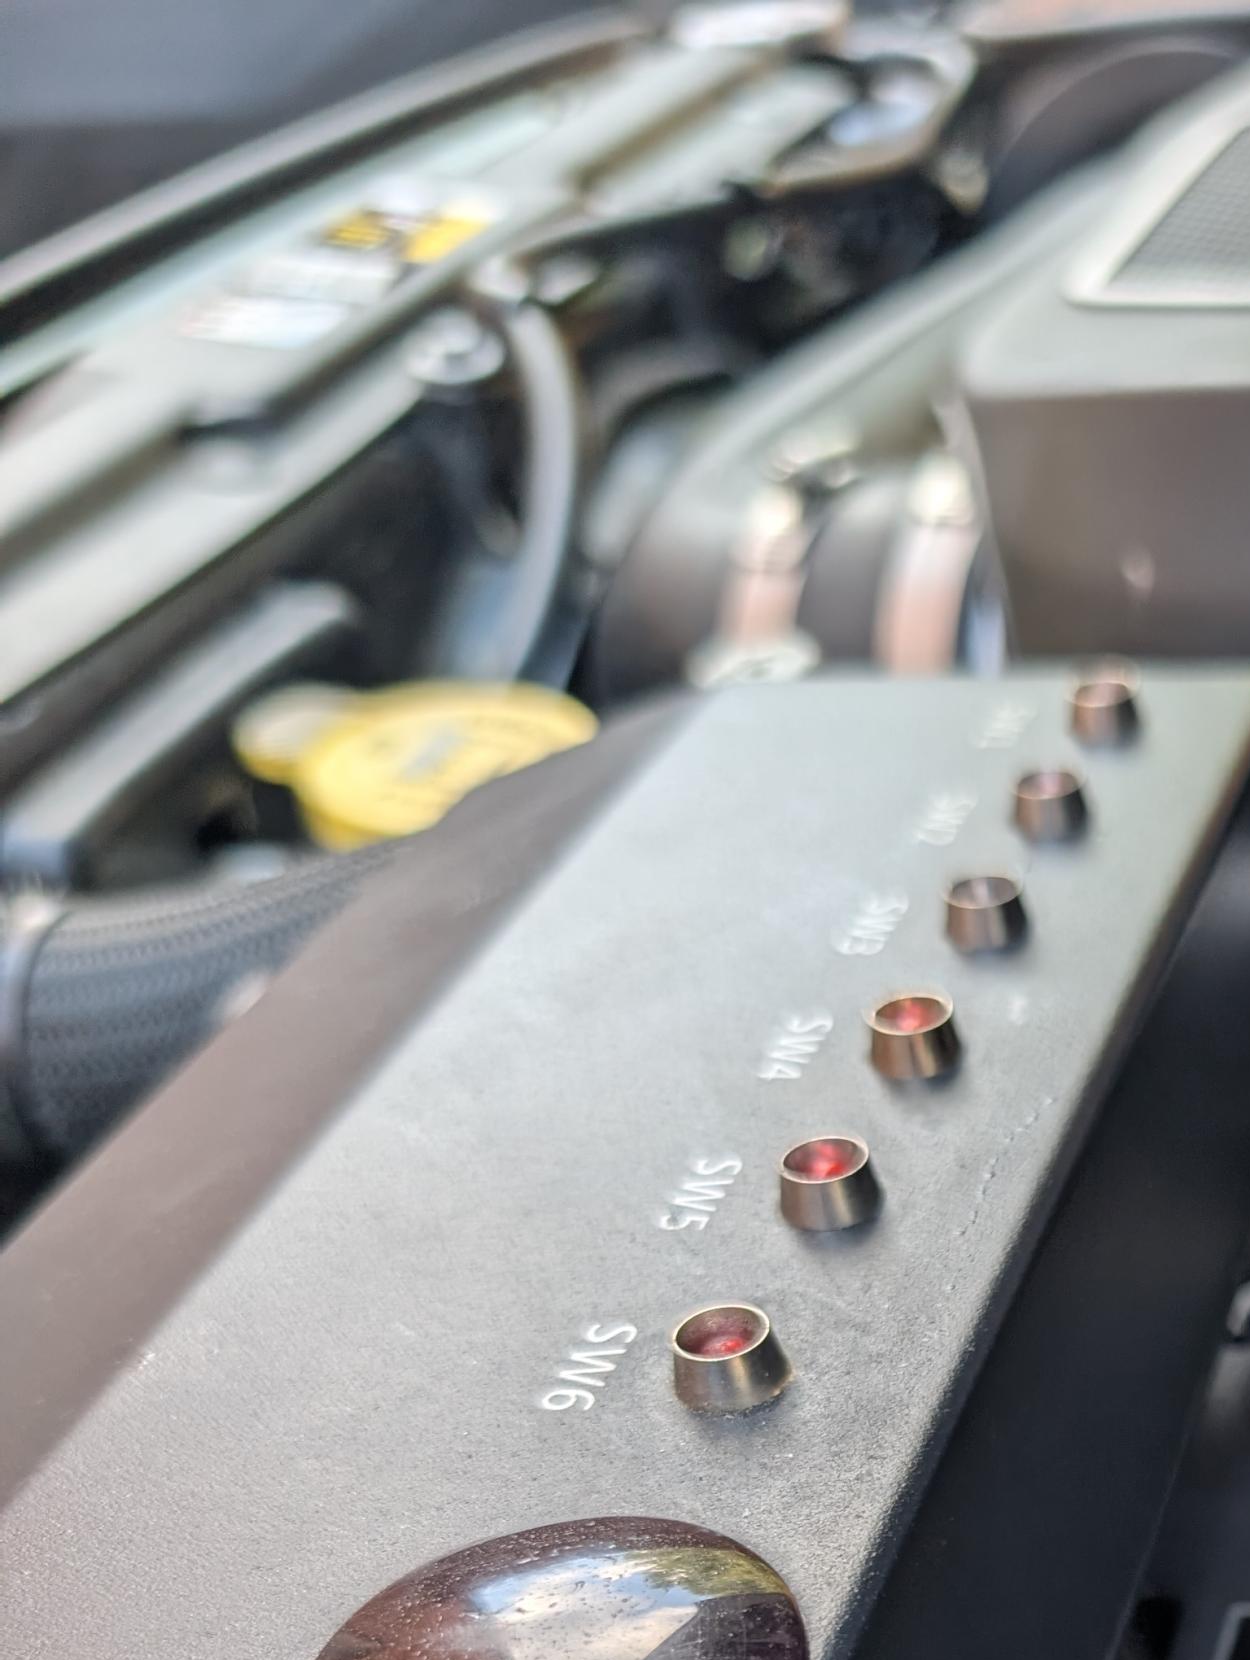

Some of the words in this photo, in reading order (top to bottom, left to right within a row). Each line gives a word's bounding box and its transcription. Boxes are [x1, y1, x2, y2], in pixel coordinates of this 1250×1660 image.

[758, 1010, 834, 1082] SW4
[660, 1151, 742, 1232] SW5
[541, 1322, 638, 1412] SW6
